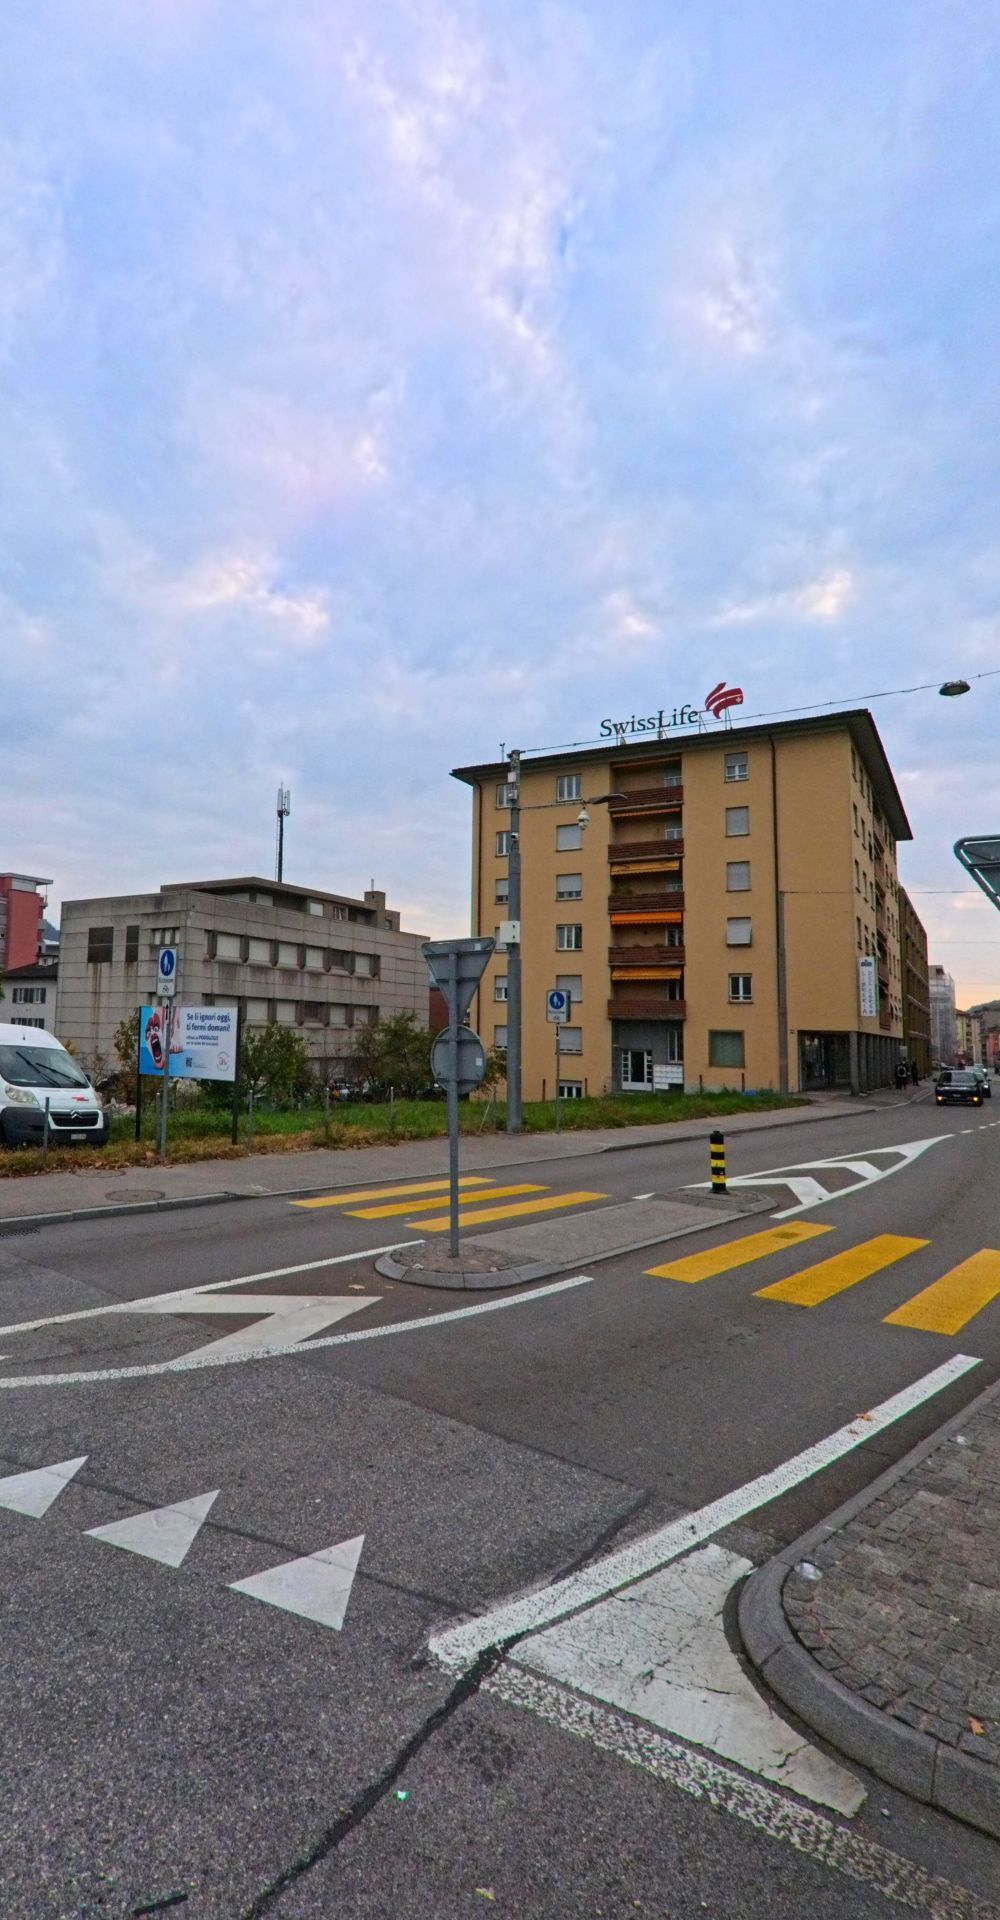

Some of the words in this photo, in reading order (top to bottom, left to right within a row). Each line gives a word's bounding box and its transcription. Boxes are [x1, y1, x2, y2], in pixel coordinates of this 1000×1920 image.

[186, 1013, 194, 1021] Se
[194, 1012, 198, 1020] li
[200, 1012, 216, 1022] ignori
[217, 1012, 231, 1023] oggi,
[186, 1022, 191, 1031] ti
[191, 1022, 207, 1031] fermi
